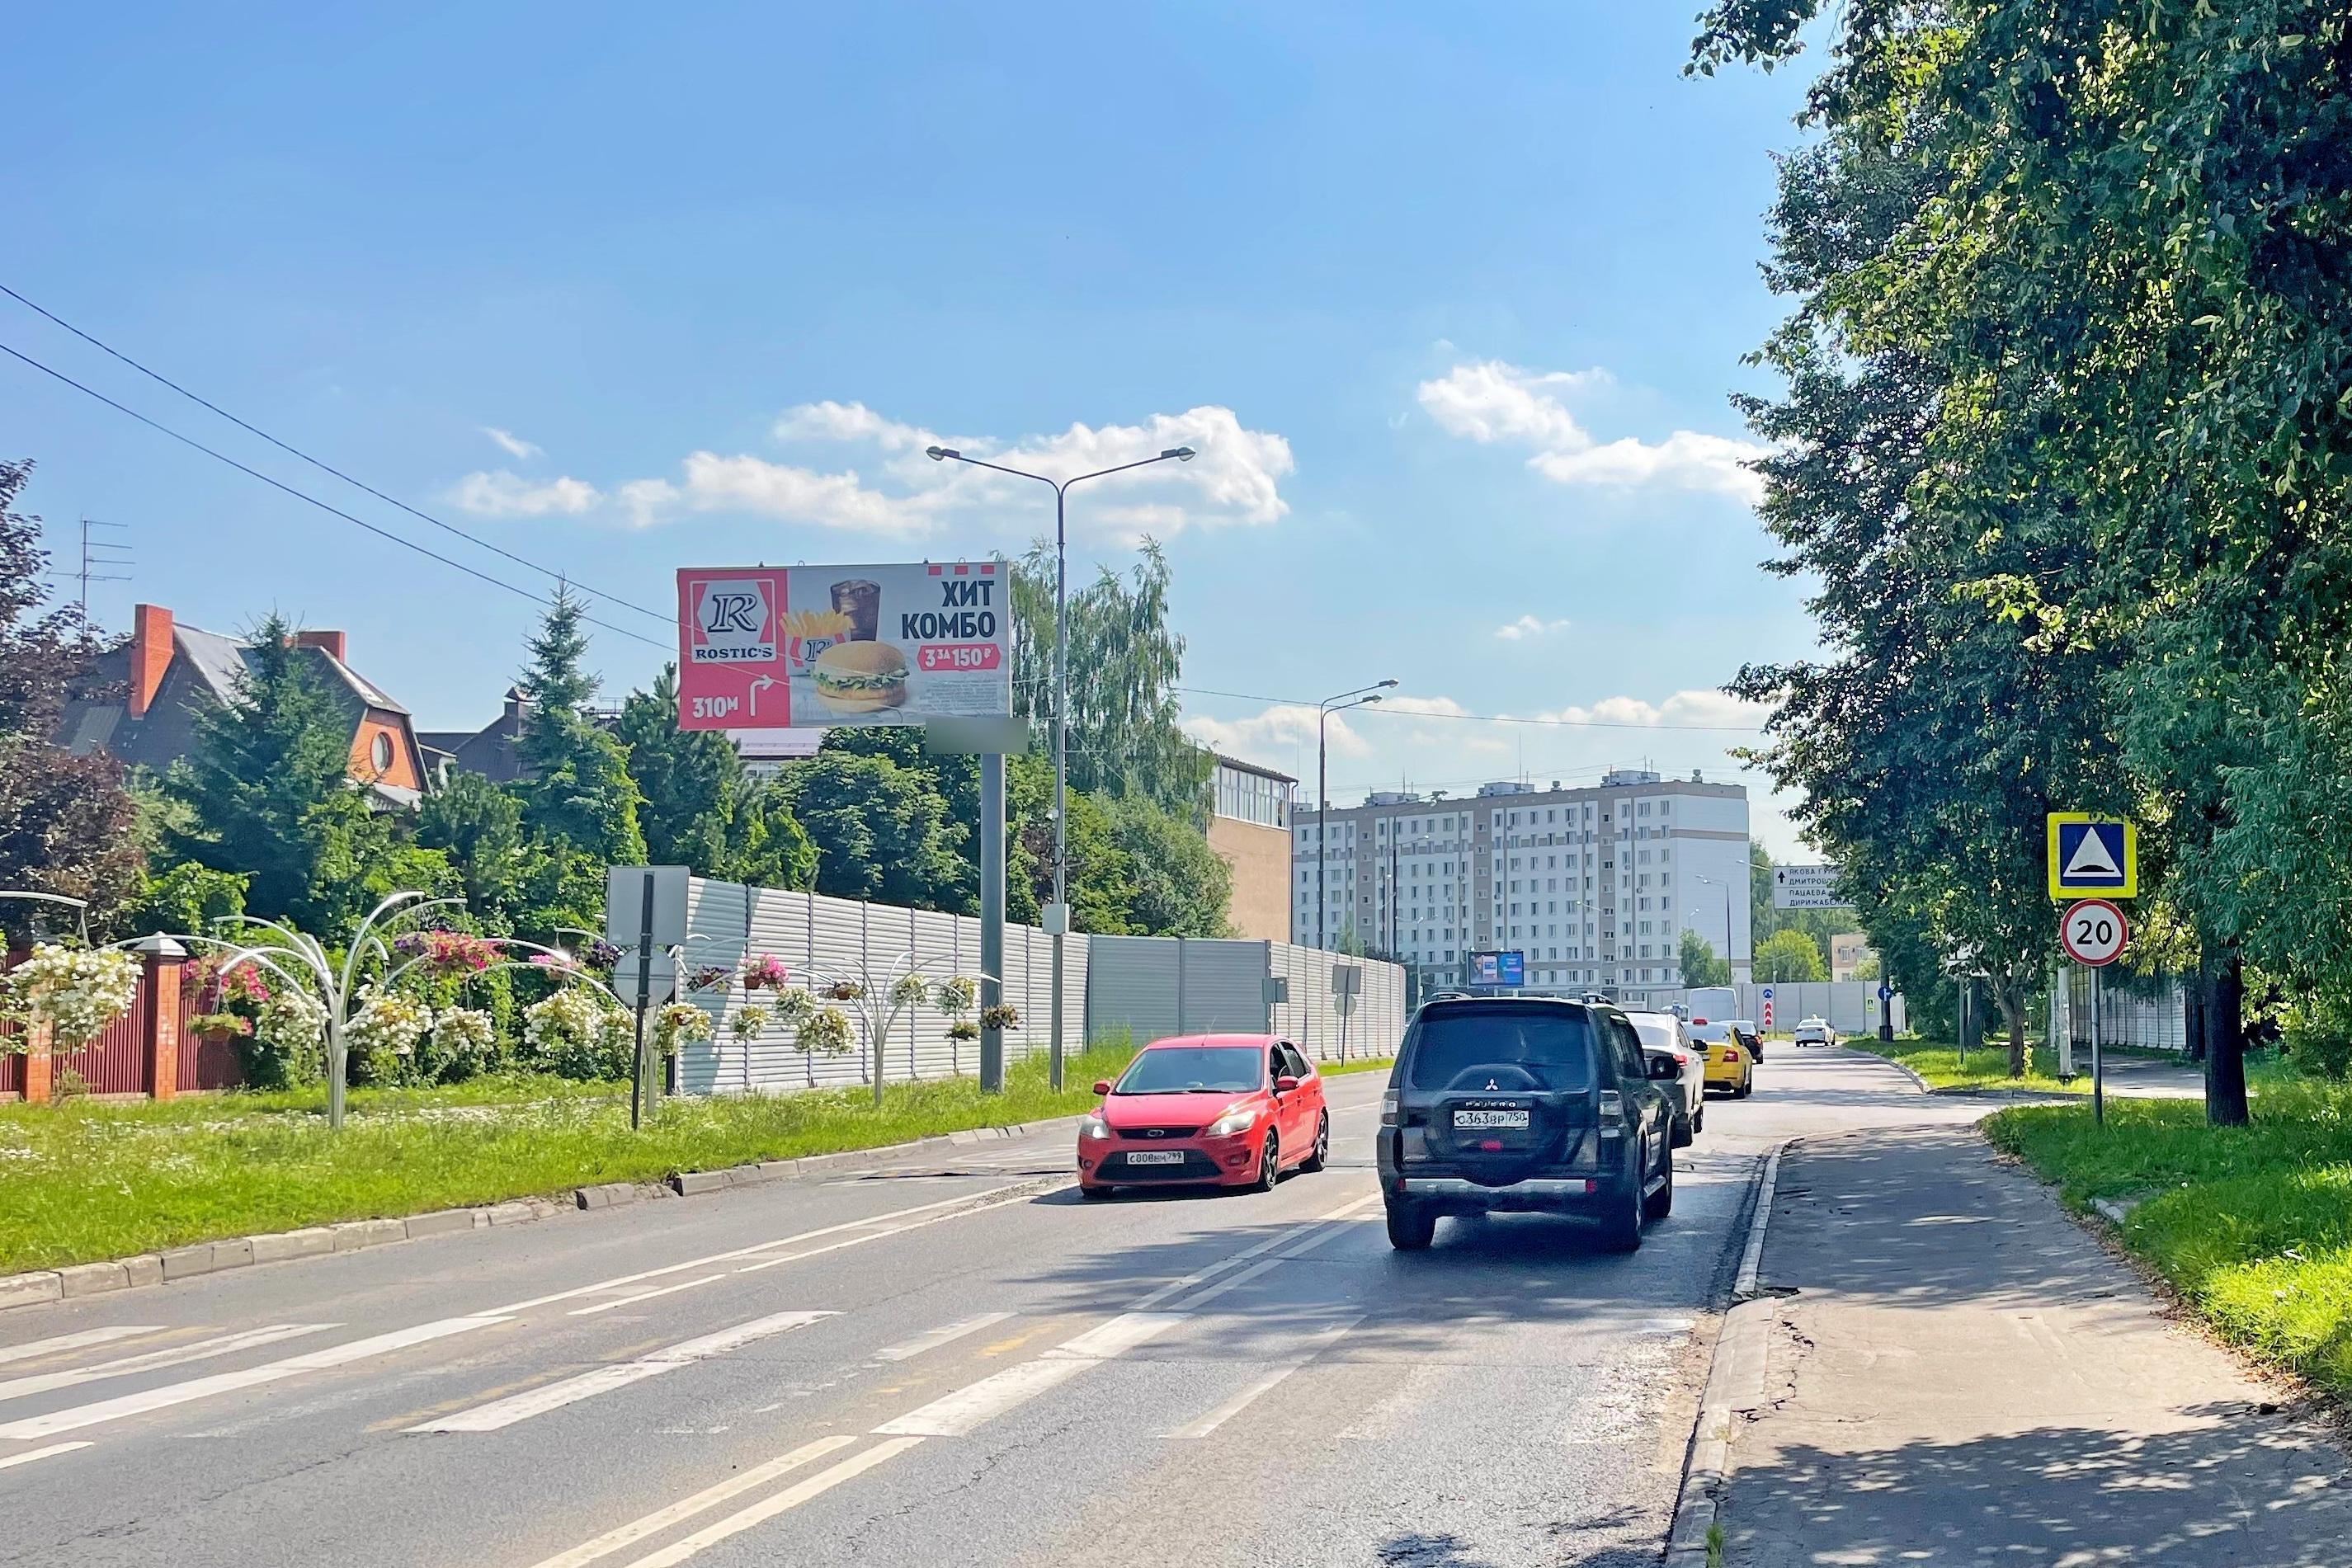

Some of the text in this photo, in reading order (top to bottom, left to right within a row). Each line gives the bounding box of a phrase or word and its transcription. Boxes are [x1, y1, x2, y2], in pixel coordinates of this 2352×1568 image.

[941, 580, 995, 607] ХИТ
[902, 611, 996, 640] КОМБО
[695, 646, 774, 660] ROSTIC'S
[2076, 920, 2112, 945] 20
